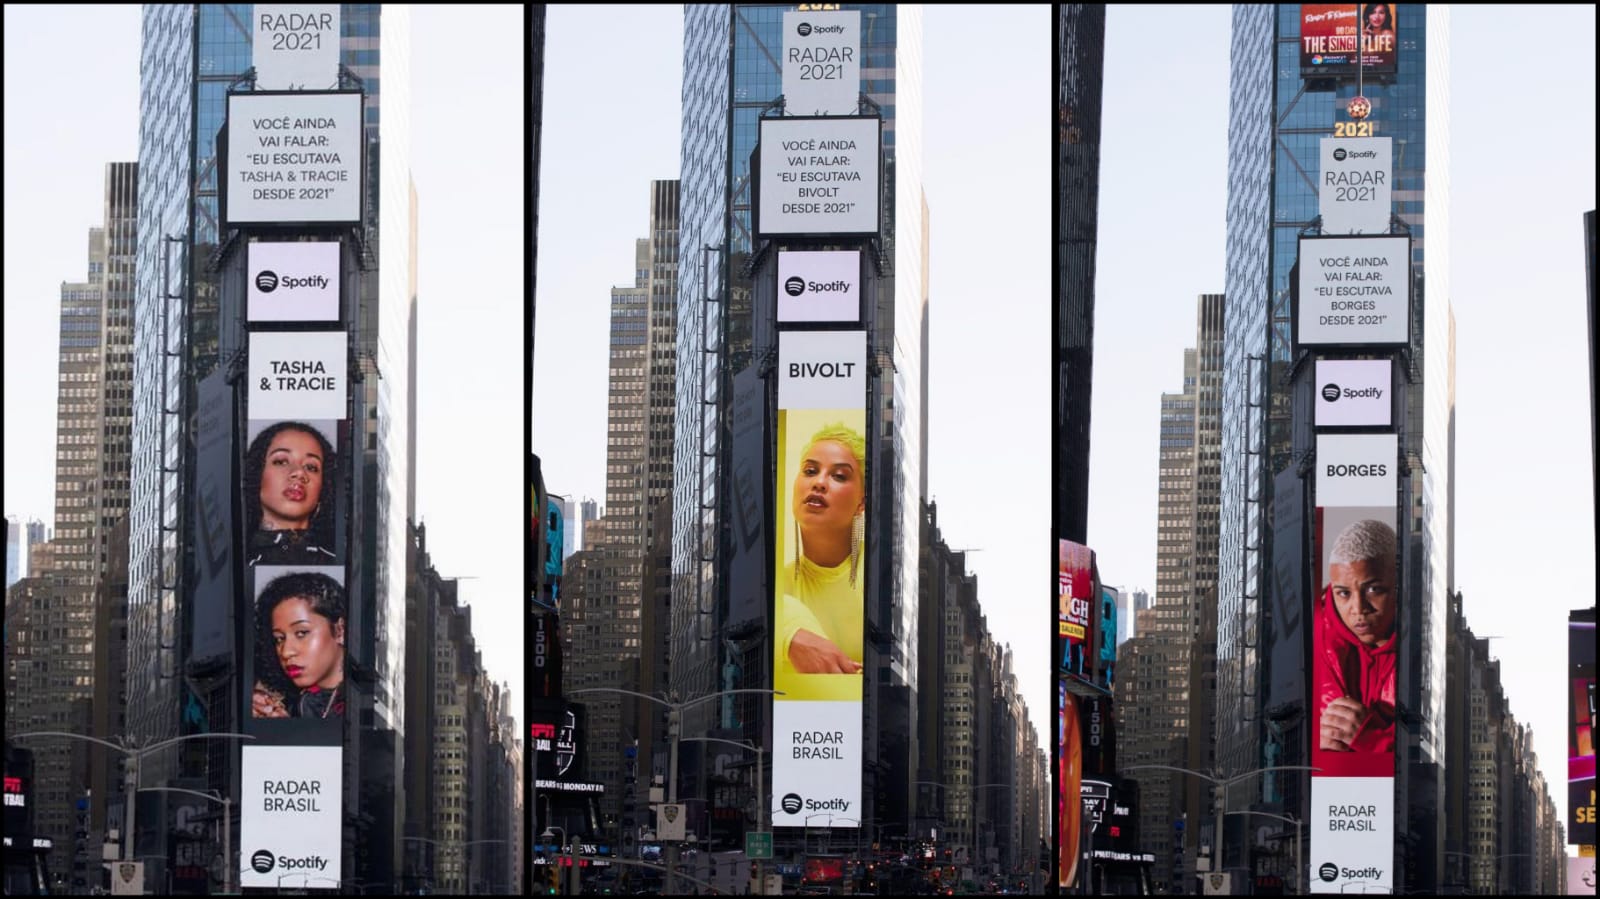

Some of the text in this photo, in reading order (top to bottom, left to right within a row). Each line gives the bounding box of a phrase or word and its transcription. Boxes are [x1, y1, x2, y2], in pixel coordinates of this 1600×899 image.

[261, 13, 333, 32] RADAR
[813, 25, 845, 35] Spotify
[273, 33, 321, 51] 2021
[1303, 34, 1393, 53] THE SINGL LIFE
[789, 47, 853, 63] RADAR
[799, 64, 843, 80] 2021
[253, 116, 337, 130] VOCÊ AINDA
[1334, 122, 1374, 137] 2021
[259, 135, 329, 147] VAI FALAR:
[782, 138, 857, 151] VOCÊ AINDA
[246, 152, 342, 165] “EU ESCUTAVA
[788, 156, 850, 167] VAI FALAR:
[1348, 150, 1377, 160] Spotify
[240, 170, 348, 183] TASHA & TRACIE
[801, 171, 862, 183] ESCUTAVA
[1325, 171, 1385, 186] RADAR
[252, 189, 295, 200] DESDE
[798, 187, 840, 198] BIVOLT
[1335, 187, 1376, 202] 2021
[782, 204, 821, 214] DESDE
[1319, 256, 1389, 268] VOCÊ AINDA
[281, 275, 329, 290] Spotify
[1324, 271, 1383, 281] VAI FALAR:
[808, 281, 851, 294] Spotify
[1336, 285, 1393, 296] ESCUTAVA
[1331, 301, 1376, 311] BORGES
[1319, 315, 1355, 326] DESDE
[270, 361, 326, 375] TASHA
[789, 362, 856, 379] BIVOLT
[260, 376, 336, 391] & TRACIE
[1343, 386, 1383, 400] Spotify
[1327, 464, 1387, 477] BORGES
[535, 618, 545, 667] 1500
[1090, 700, 1100, 747] 1500
[792, 731, 844, 745] RADAR
[792, 747, 844, 760] BRASIL
[263, 780, 321, 796] RADAR
[263, 797, 321, 813] BRASIL
[806, 797, 850, 813] Spotify
[1328, 804, 1376, 818] RADAR
[1328, 819, 1377, 832] BRASIL
[277, 855, 328, 872] Spotify
[1341, 866, 1383, 880] Spotify
